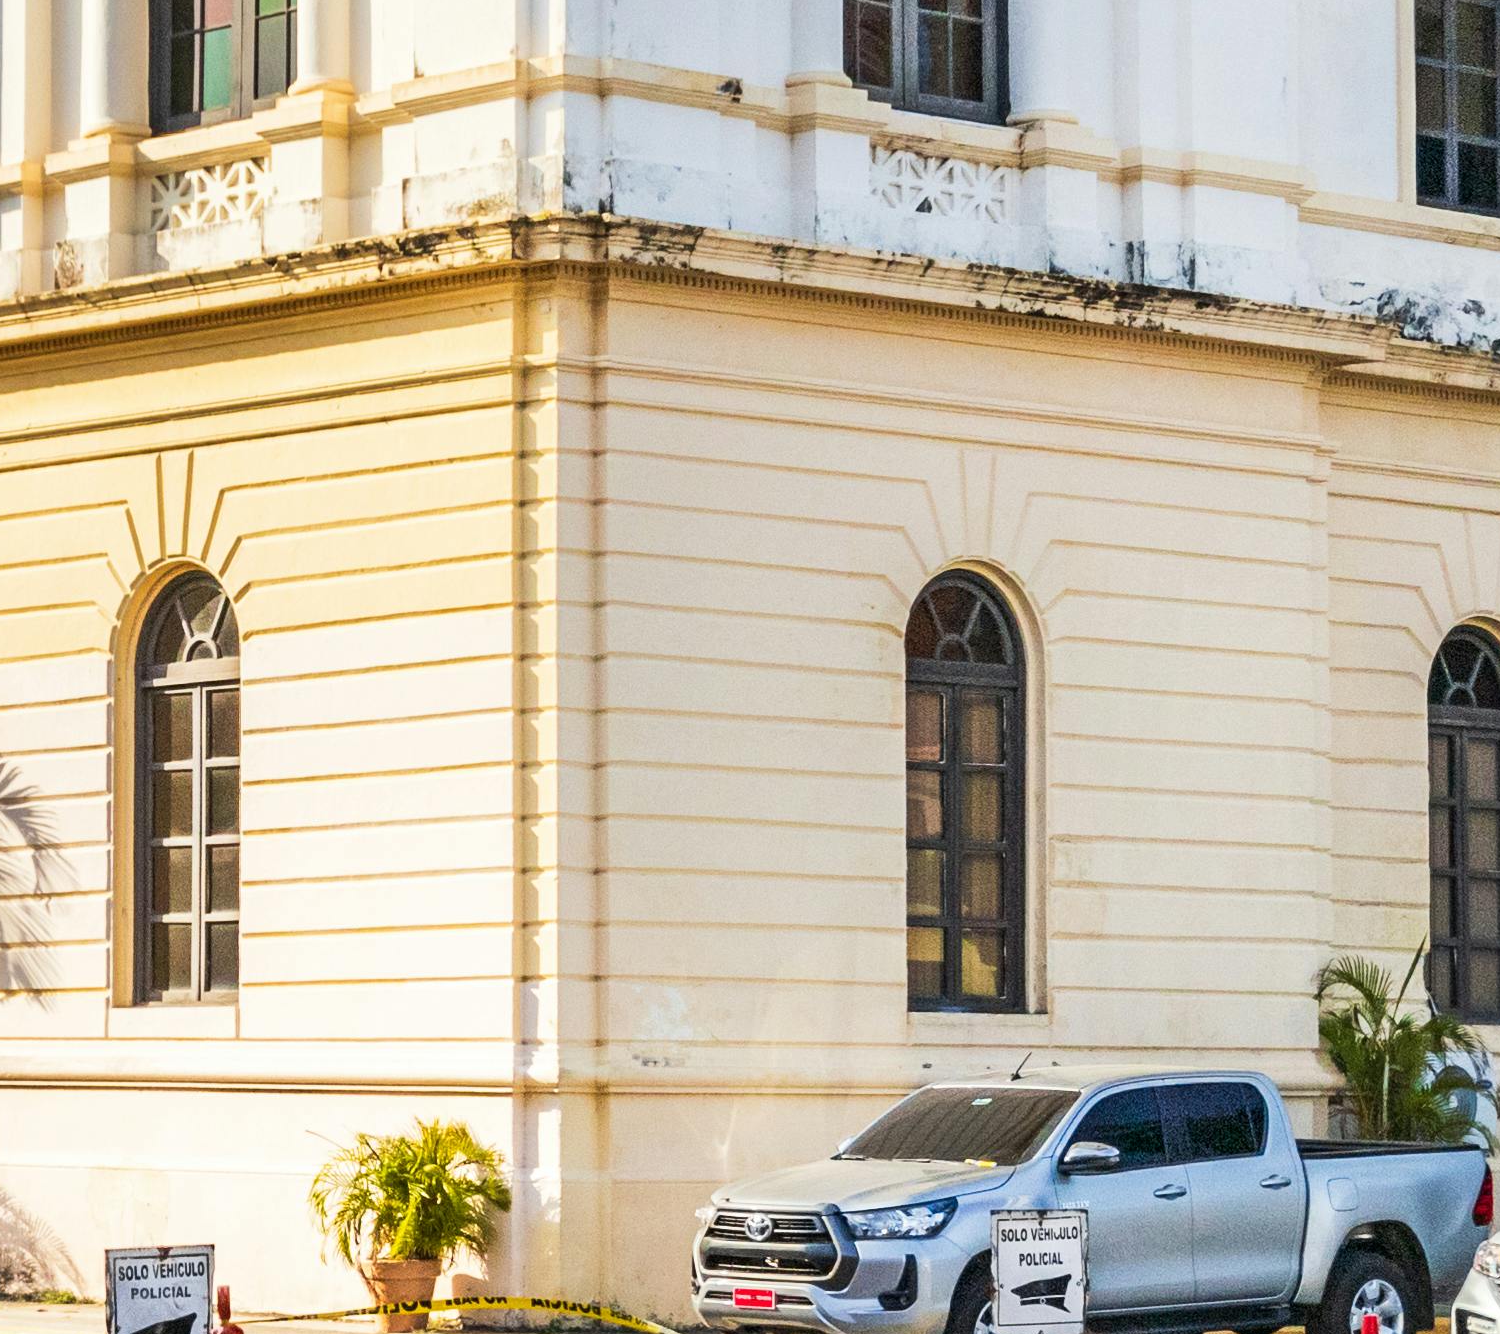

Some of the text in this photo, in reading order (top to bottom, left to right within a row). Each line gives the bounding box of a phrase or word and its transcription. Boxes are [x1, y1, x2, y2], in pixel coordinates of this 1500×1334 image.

[1001, 1228, 1027, 1242] SOLO
[1019, 1252, 1063, 1267] POLICIAL
[118, 1261, 205, 1281] SOLO VEHICULO
[130, 1286, 191, 1300] POLICIAL
